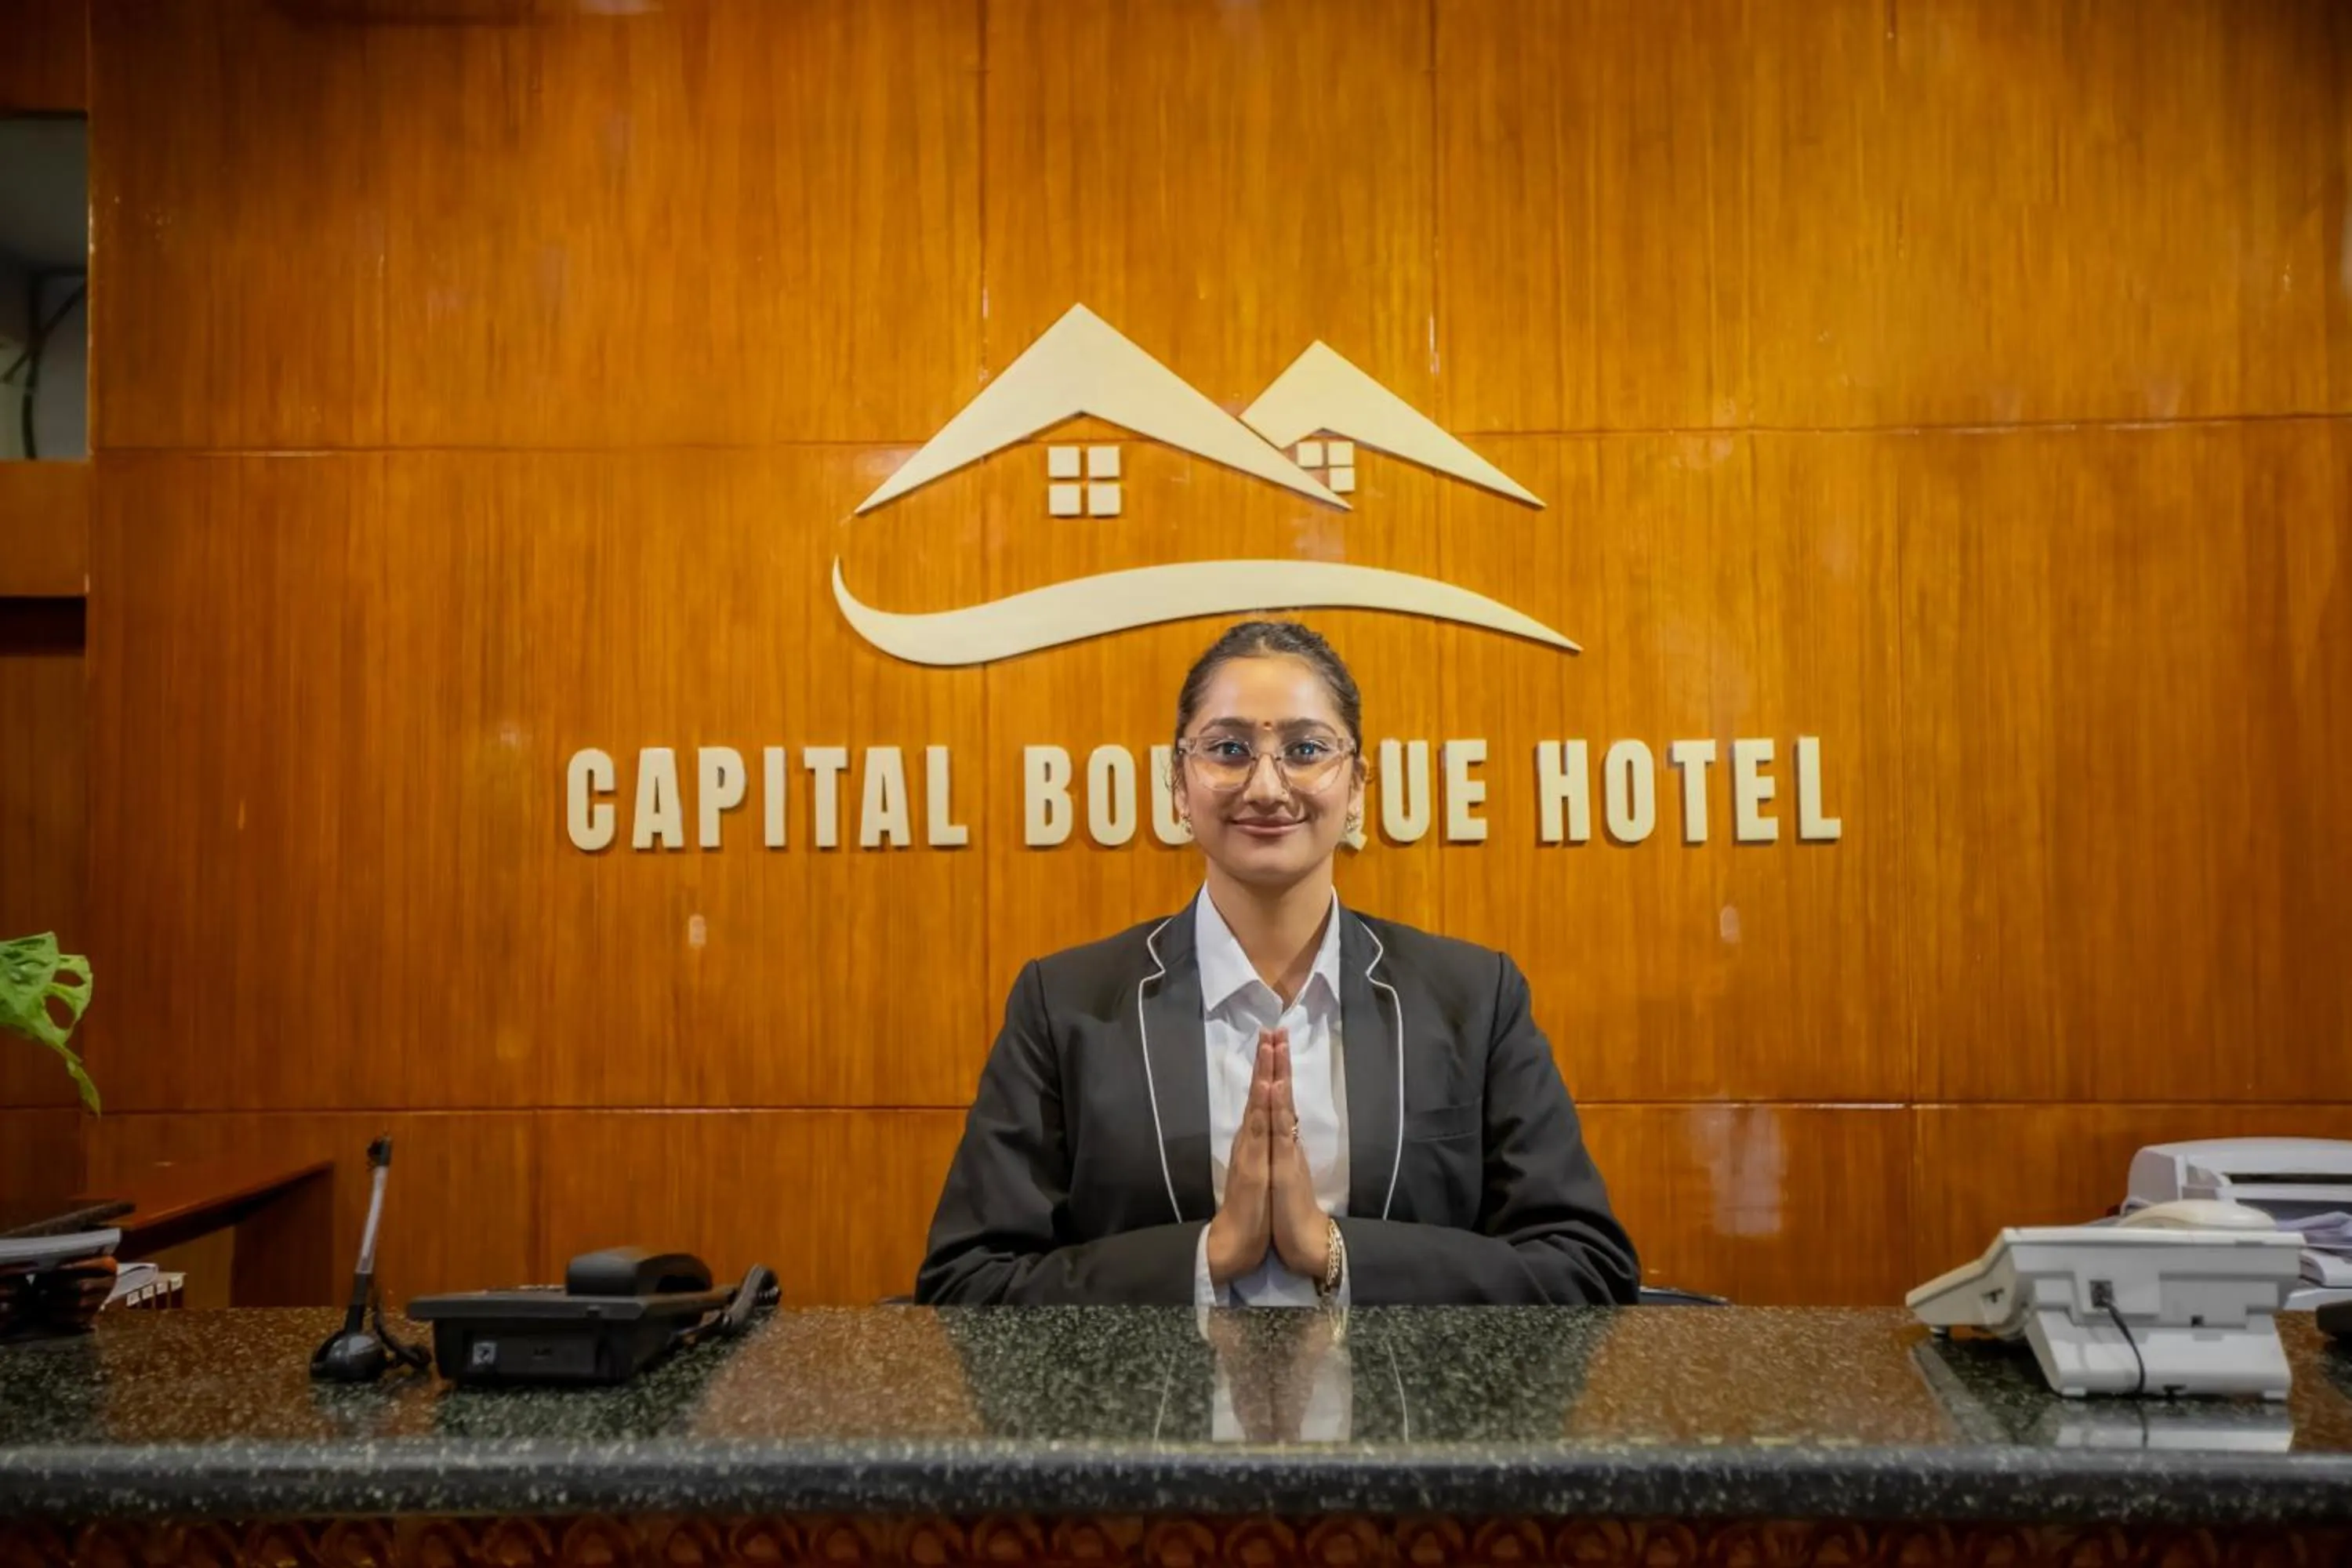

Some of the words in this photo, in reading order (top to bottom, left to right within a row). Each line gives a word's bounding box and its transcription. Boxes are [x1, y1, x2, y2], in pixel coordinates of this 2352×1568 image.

[567, 746, 968, 851] CAPITAL
[1023, 739, 1488, 851] BOUUE
[1538, 736, 1842, 843] HOTEL
